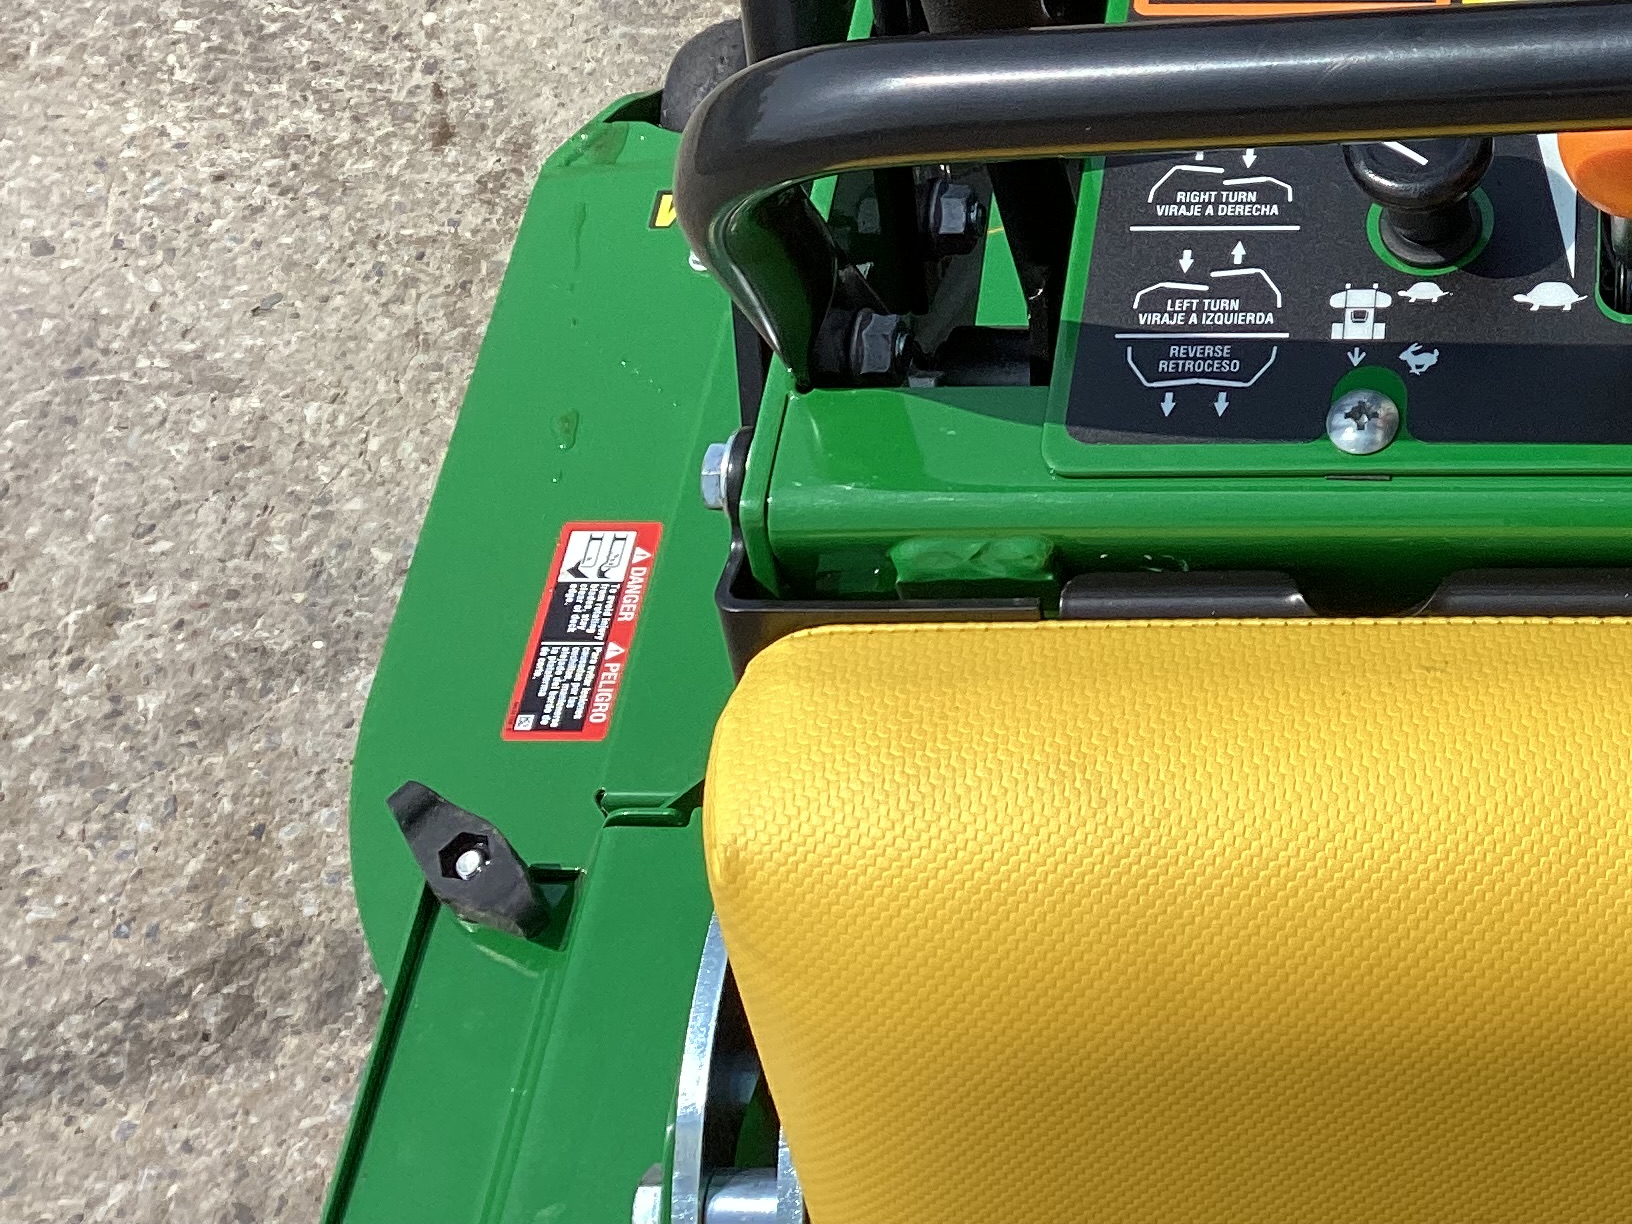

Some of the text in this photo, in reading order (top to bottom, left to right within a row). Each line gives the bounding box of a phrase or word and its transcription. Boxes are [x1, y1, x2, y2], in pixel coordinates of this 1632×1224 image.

[1177, 192, 1256, 202] RIGHT TURN
[1157, 204, 1278, 216] VIRAJE A DERECHA
[1167, 299, 1239, 311] LEFT TURN
[1139, 312, 1274, 324] VIRAJE A IZQUIERDA
[1170, 346, 1231, 357] REVERSE
[1159, 360, 1239, 372] RETROCESO
[617, 567, 647, 622] DANGER
[589, 663, 620, 723] PELIGRO
